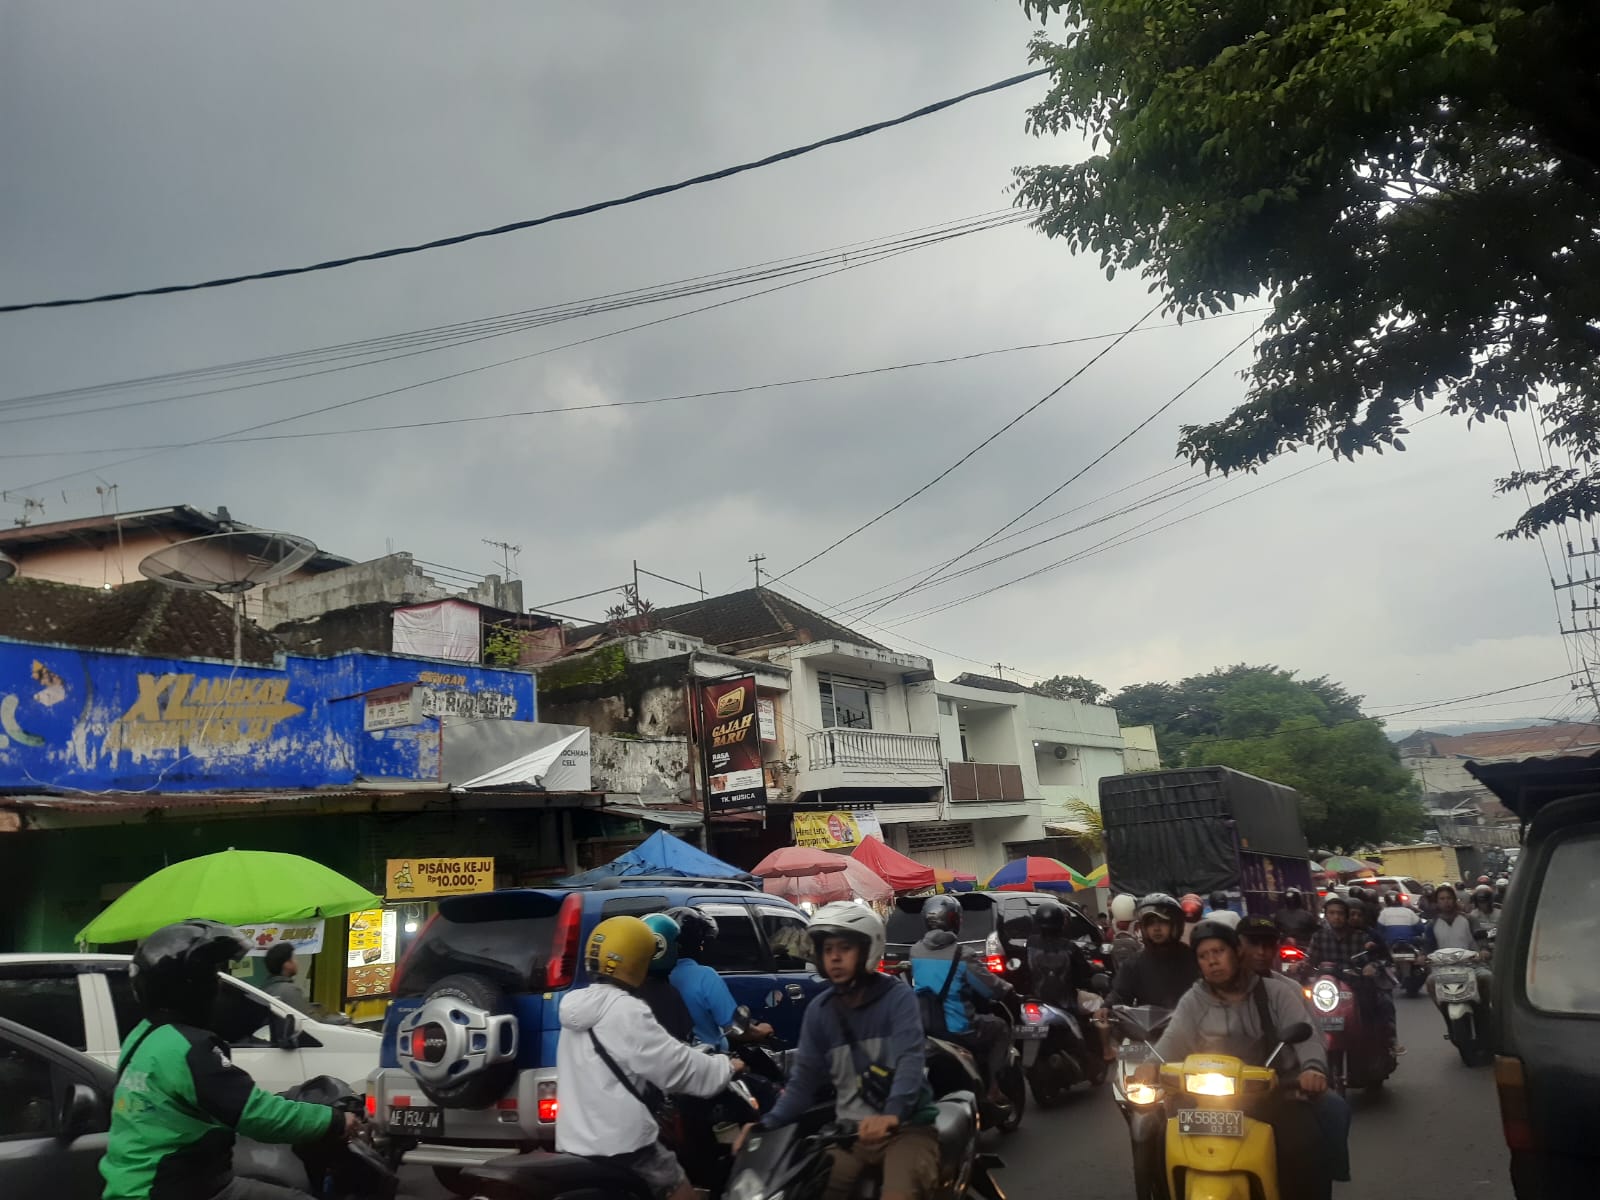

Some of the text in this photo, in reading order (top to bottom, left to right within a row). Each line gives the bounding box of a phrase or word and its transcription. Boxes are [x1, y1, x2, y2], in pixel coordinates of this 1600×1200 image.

[712, 713, 754, 738] GAJAH
[713, 729, 747, 748] BARU
[417, 861, 491, 875] PISANG KEJU
[390, 1110, 403, 1126] AE
